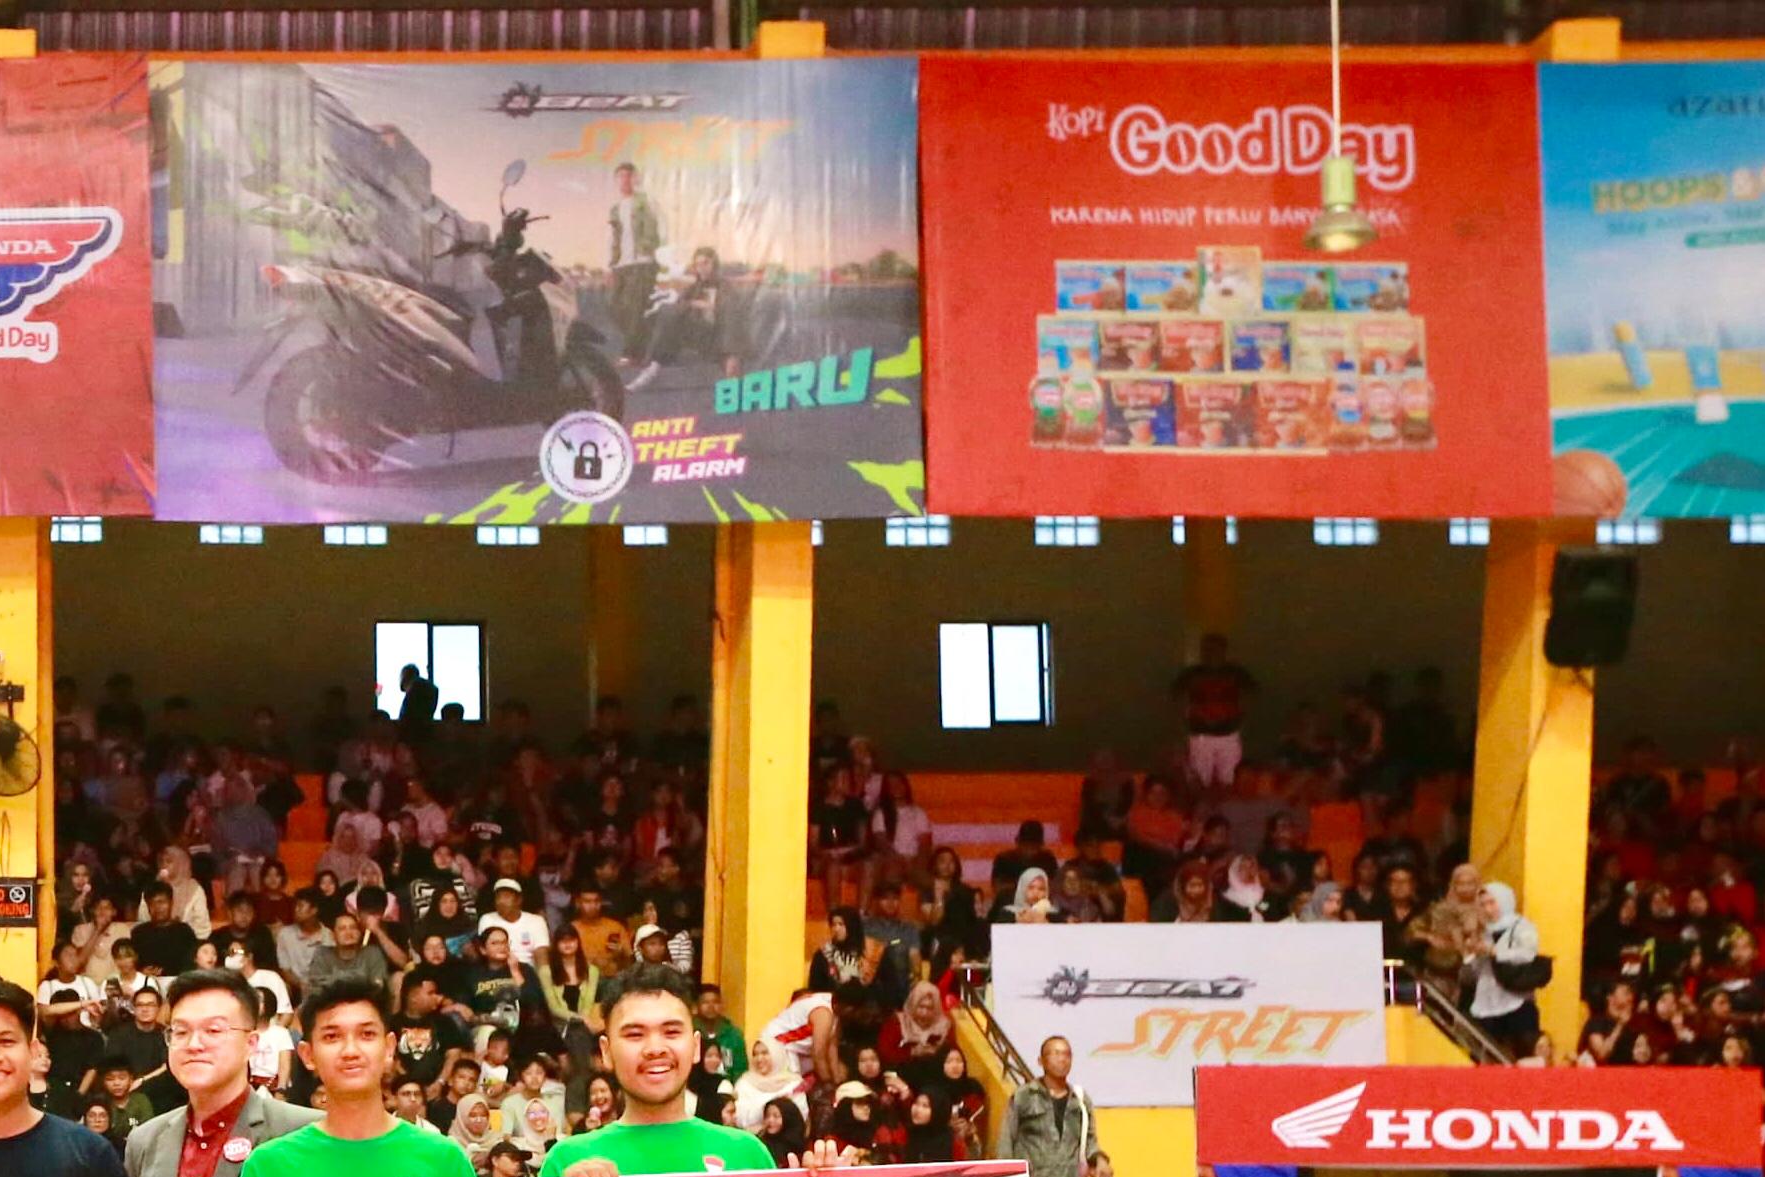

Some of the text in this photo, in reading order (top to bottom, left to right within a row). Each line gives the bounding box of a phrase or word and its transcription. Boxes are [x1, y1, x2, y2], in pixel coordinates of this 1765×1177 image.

[1050, 205, 1132, 225] KARENA
[1139, 205, 1197, 226] HIDUP
[1204, 205, 1261, 225] PERLU
[715, 347, 873, 415] BARU
[632, 417, 695, 438] ANTI
[635, 433, 743, 463] THEFT
[652, 458, 747, 483] ALARM
[1092, 1005, 1375, 1059] STREET
[1366, 1108, 1684, 1152] HONDA
